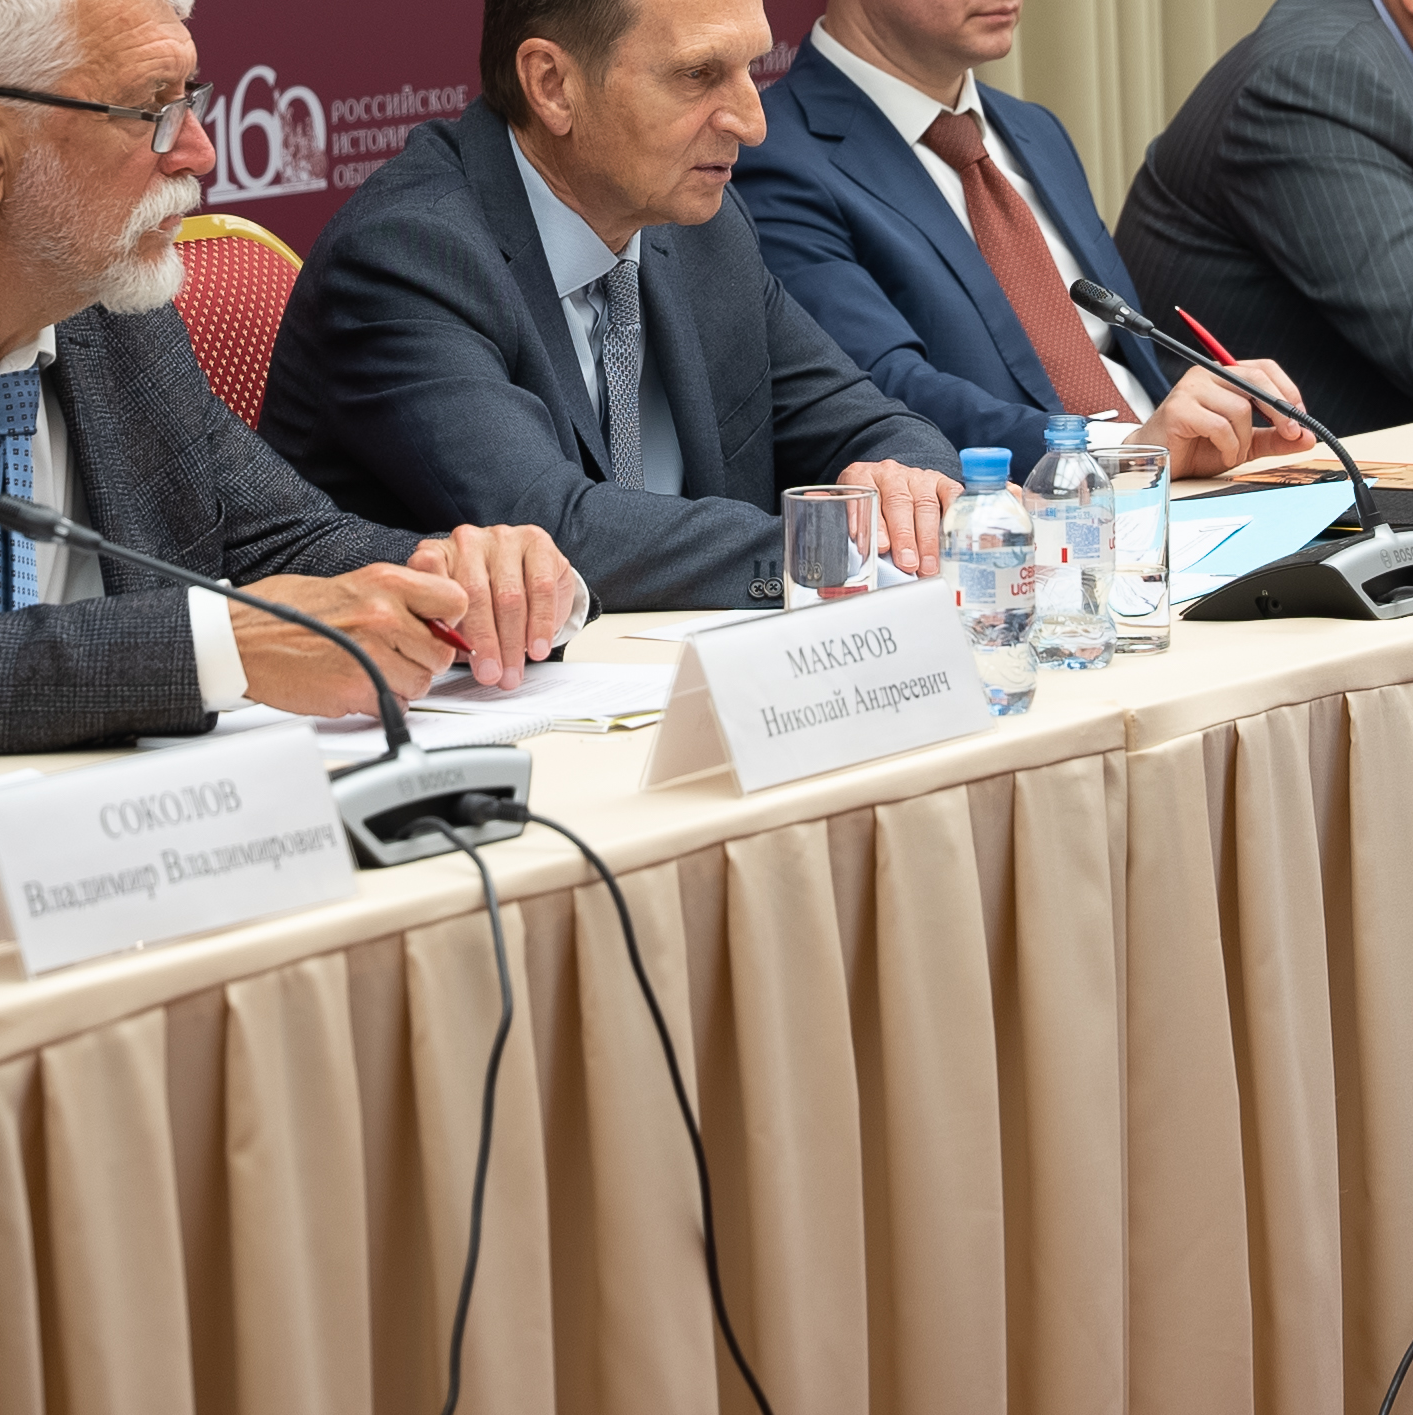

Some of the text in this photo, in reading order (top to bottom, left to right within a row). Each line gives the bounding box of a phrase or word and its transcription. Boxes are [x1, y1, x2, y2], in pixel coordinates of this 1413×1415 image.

[331, 84, 468, 126] РОССИЙСКОЕ
[786, 626, 898, 678] МАКАРОВ
[761, 671, 951, 737] Николай Андреевич
[99, 779, 242, 840] СОКОЛОВ
[23, 823, 339, 918] Владимир Владимирович
